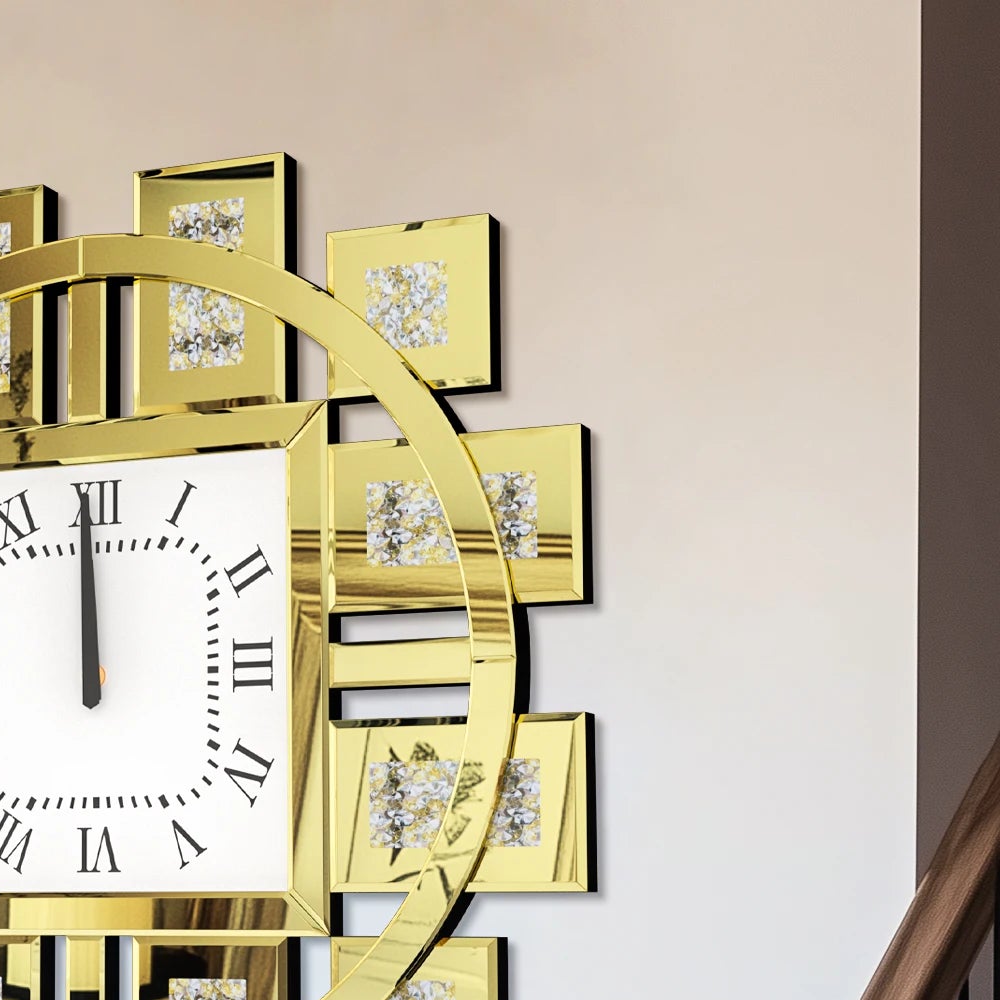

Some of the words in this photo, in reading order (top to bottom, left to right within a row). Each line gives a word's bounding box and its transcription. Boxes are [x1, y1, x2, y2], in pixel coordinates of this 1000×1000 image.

[165, 480, 197, 527] I
[224, 544, 273, 598] II
[232, 636, 273, 692] III
[223, 738, 275, 807] IV
[77, 826, 121, 873] VI
[172, 819, 207, 869] V
